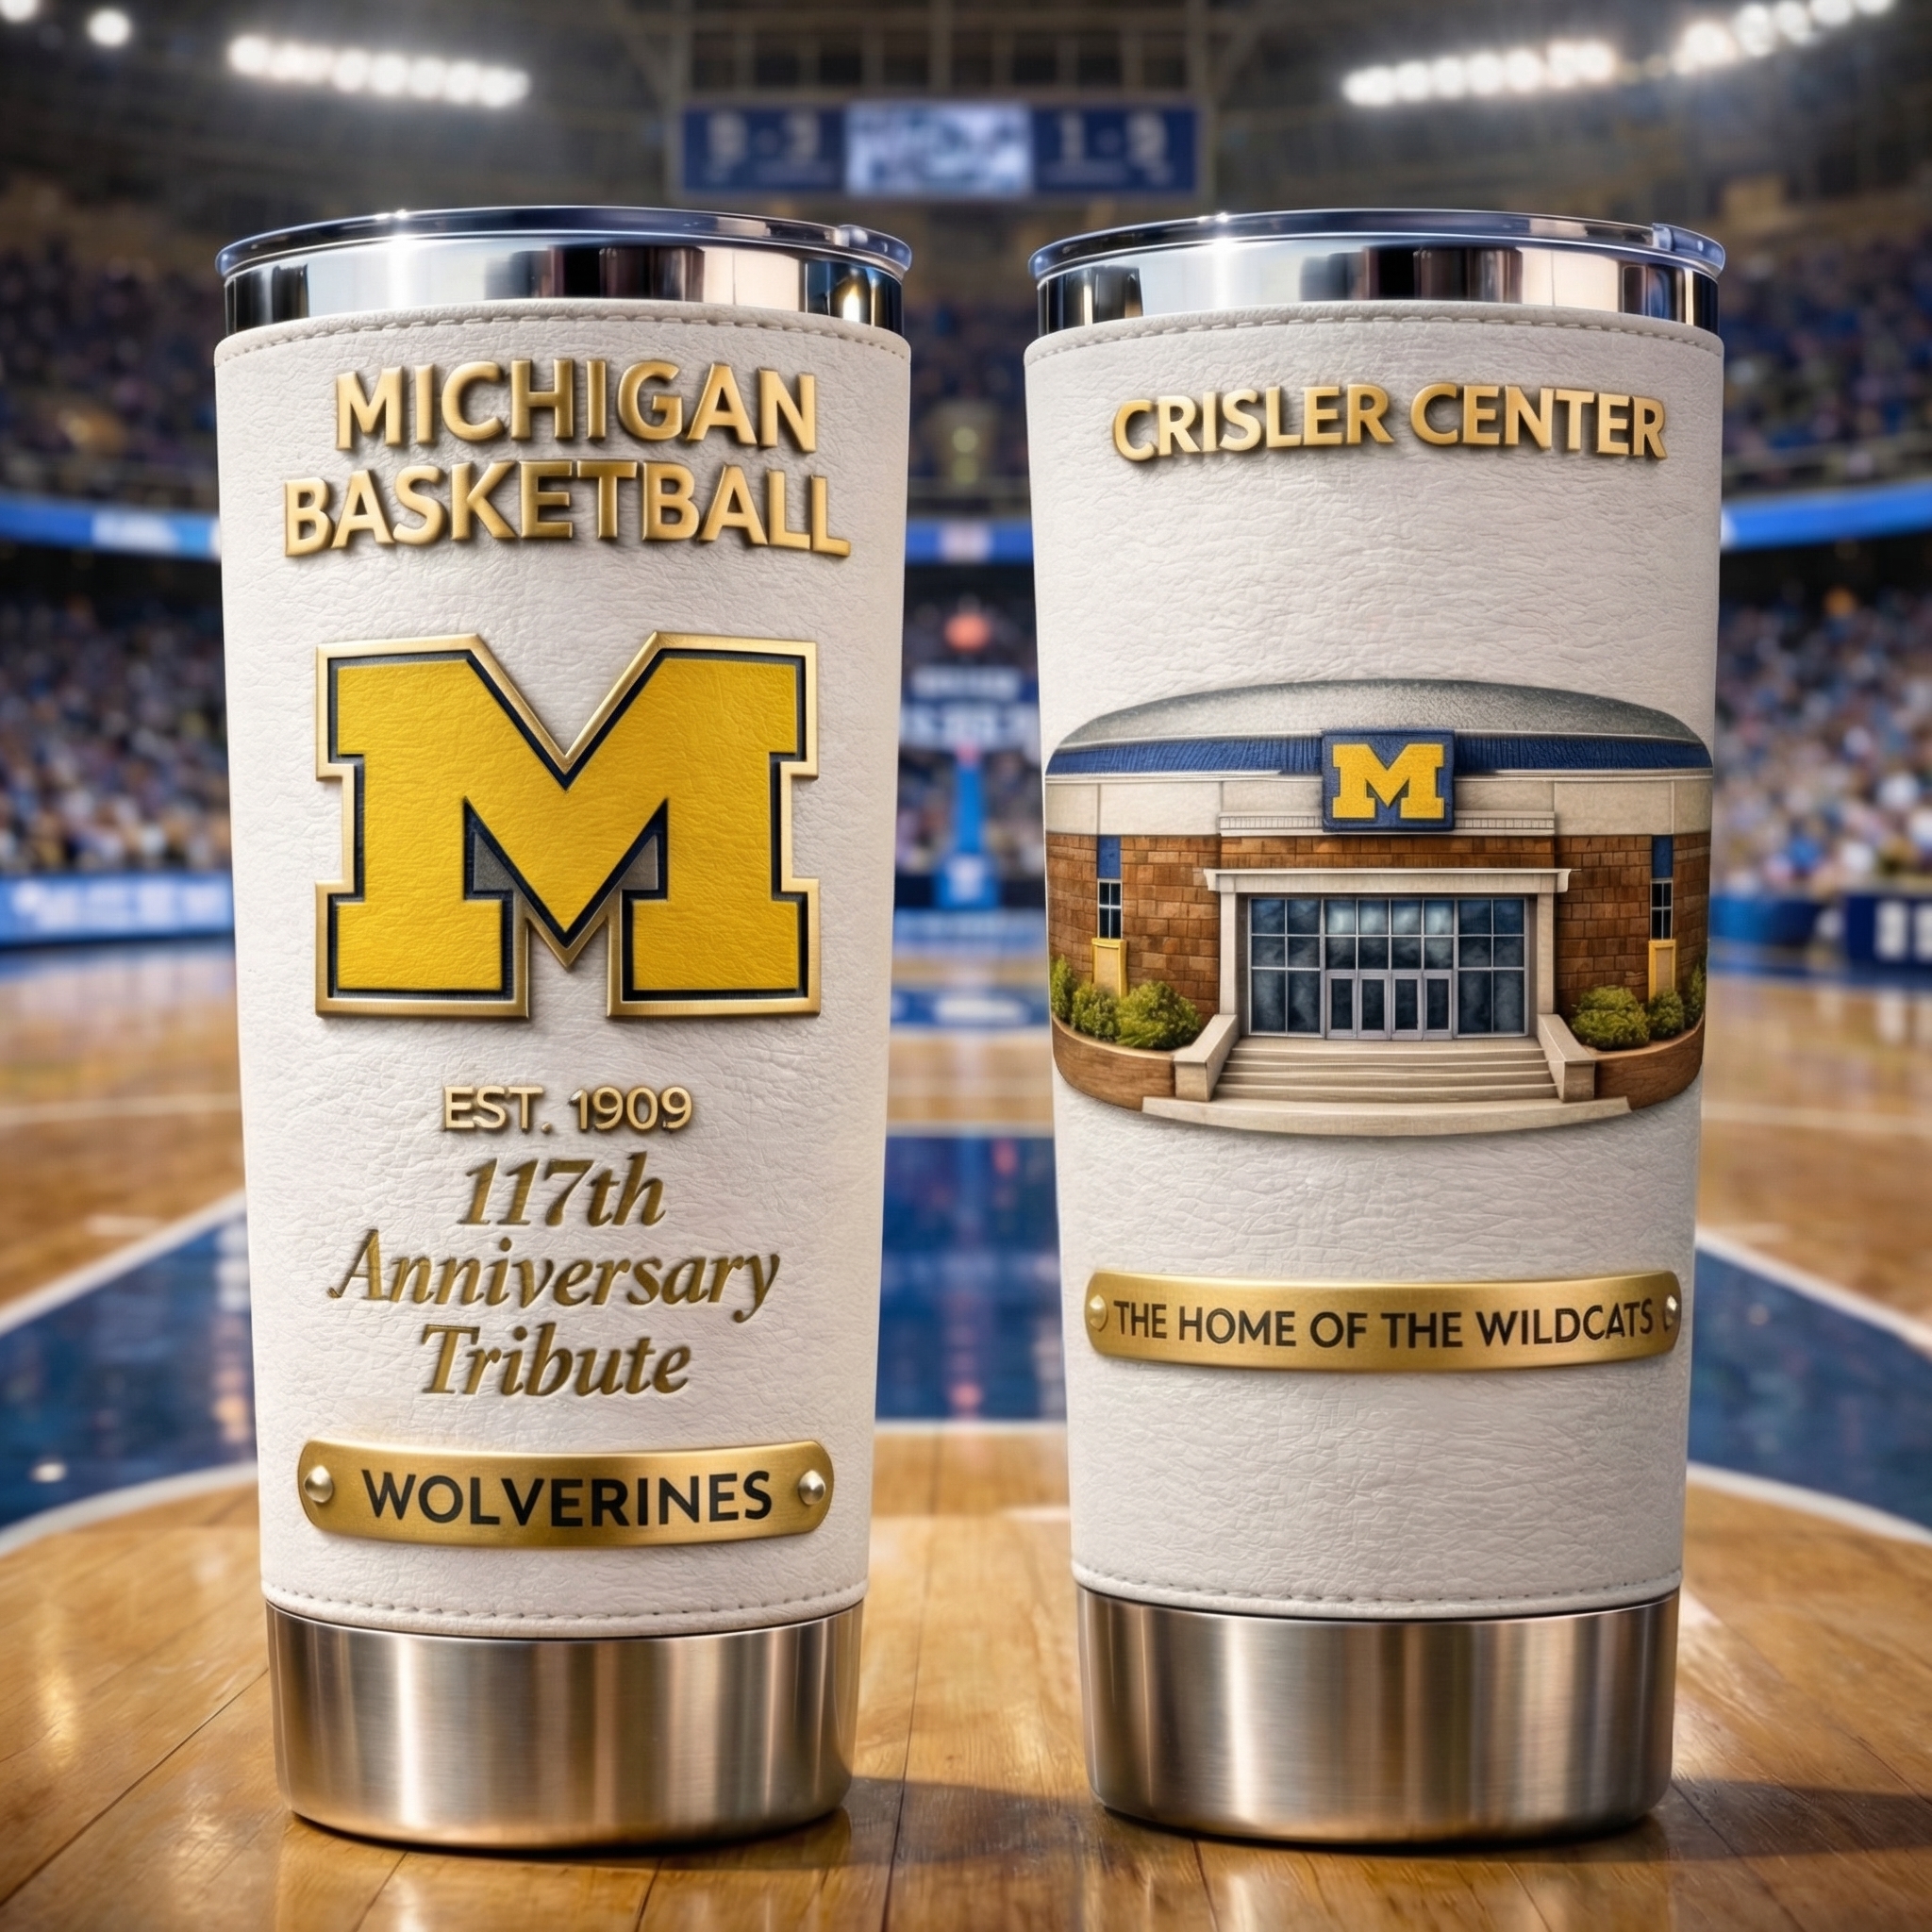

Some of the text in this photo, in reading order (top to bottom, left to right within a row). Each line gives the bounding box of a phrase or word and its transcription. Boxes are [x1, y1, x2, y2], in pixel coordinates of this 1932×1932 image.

[336, 359, 816, 453] MICHIGAN
[1113, 383, 1667, 461] CRISLER CENTER
[285, 460, 851, 558] BASKETBALL
[1332, 743, 1445, 819] M
[316, 631, 821, 1019] M
[443, 1085, 693, 1132] EST. 1909
[458, 1152, 666, 1226] 117th
[327, 1228, 781, 1324] Anniversary
[421, 1322, 692, 1397] Tribute
[1113, 1298, 1653, 1349] THE HOME OF THE WILDCATS
[361, 1470, 773, 1528] WOLVERINES
